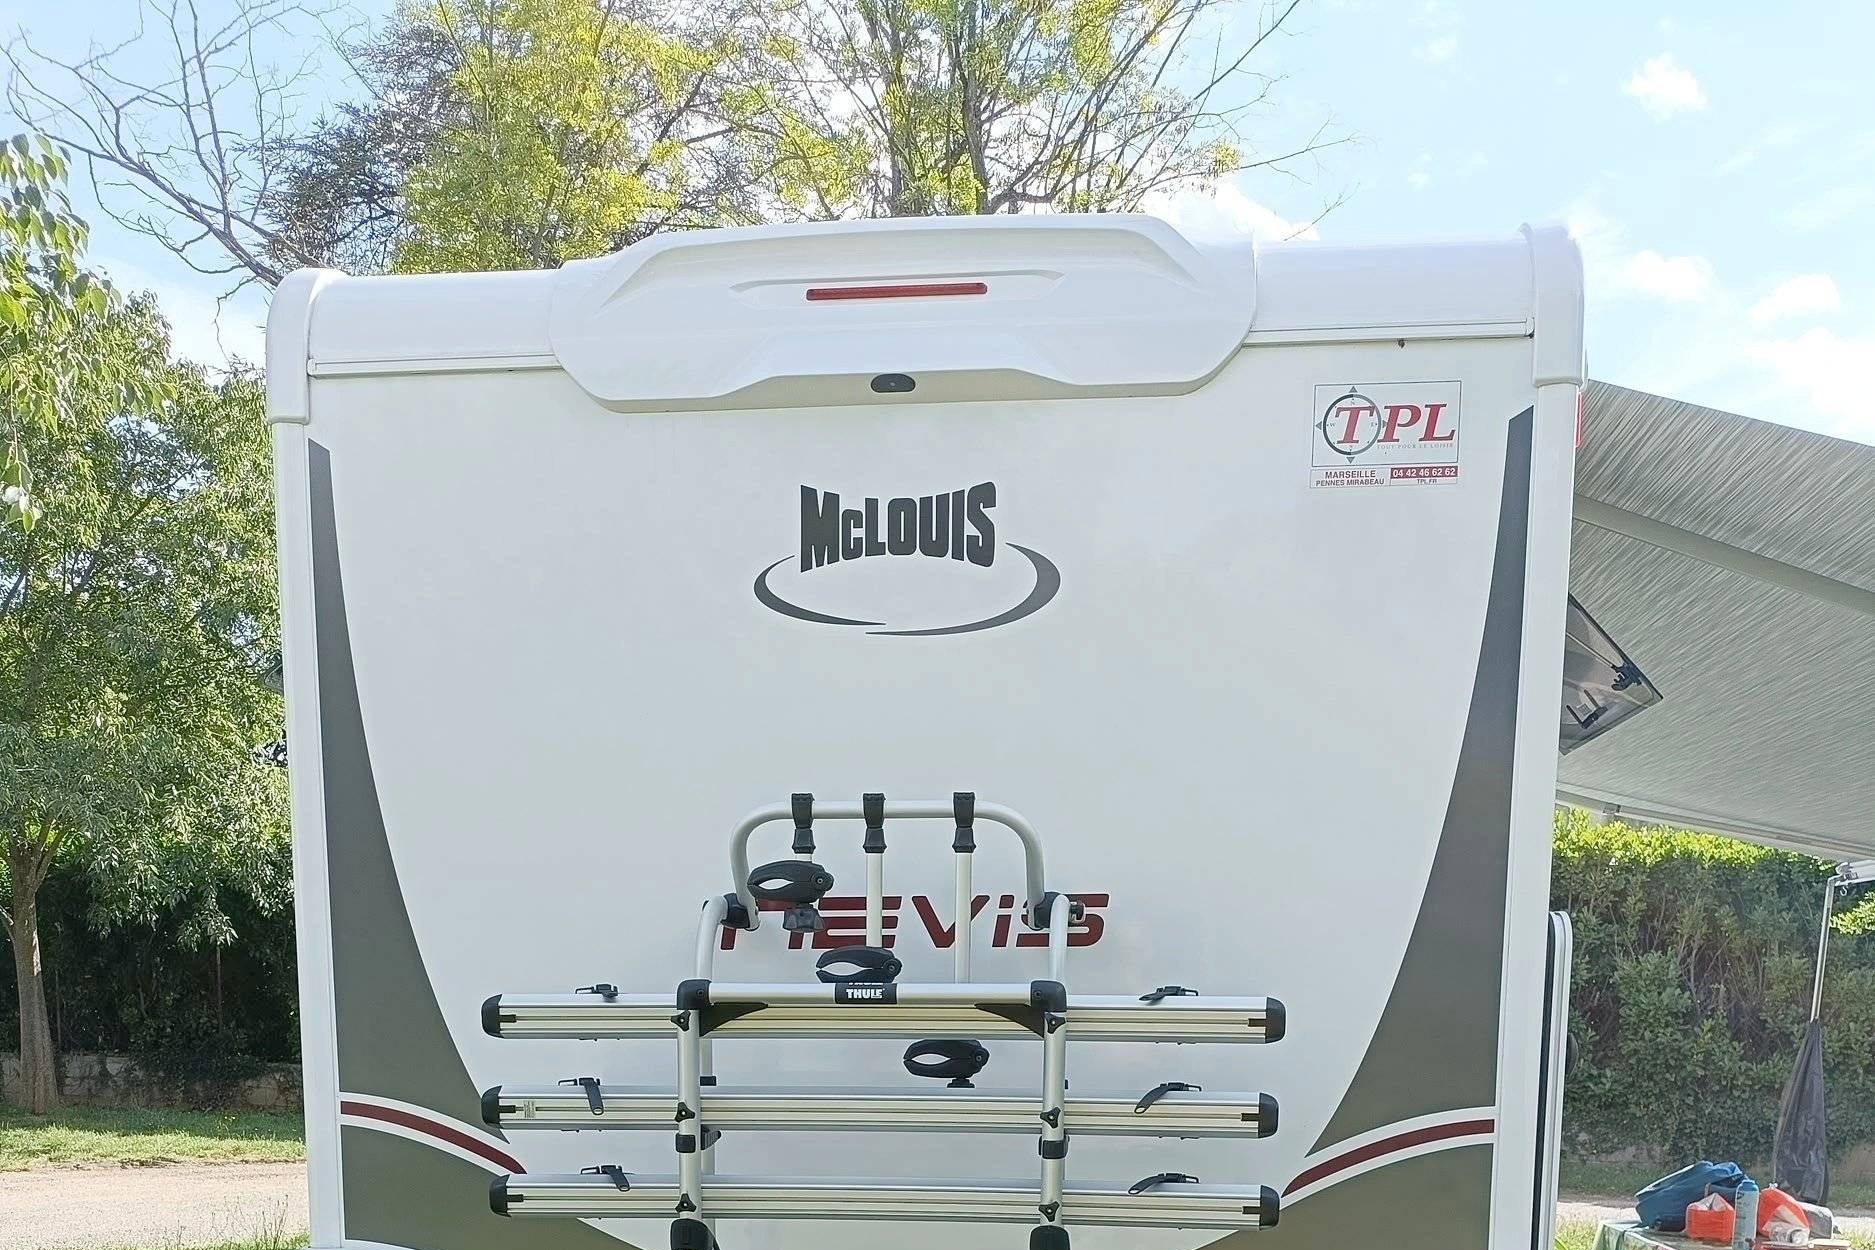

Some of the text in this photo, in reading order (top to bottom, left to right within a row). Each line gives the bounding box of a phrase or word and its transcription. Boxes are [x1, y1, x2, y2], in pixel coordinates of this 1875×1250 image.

[1335, 403, 1456, 444] TPL
[1325, 469, 1377, 479] MARSEILLE
[1392, 467, 1456, 478] 04 42 46 62 62
[1315, 478, 1385, 487] PENNES MIRABEAU
[800, 481, 997, 573] McLOUIS
[846, 988, 883, 999] THULE
